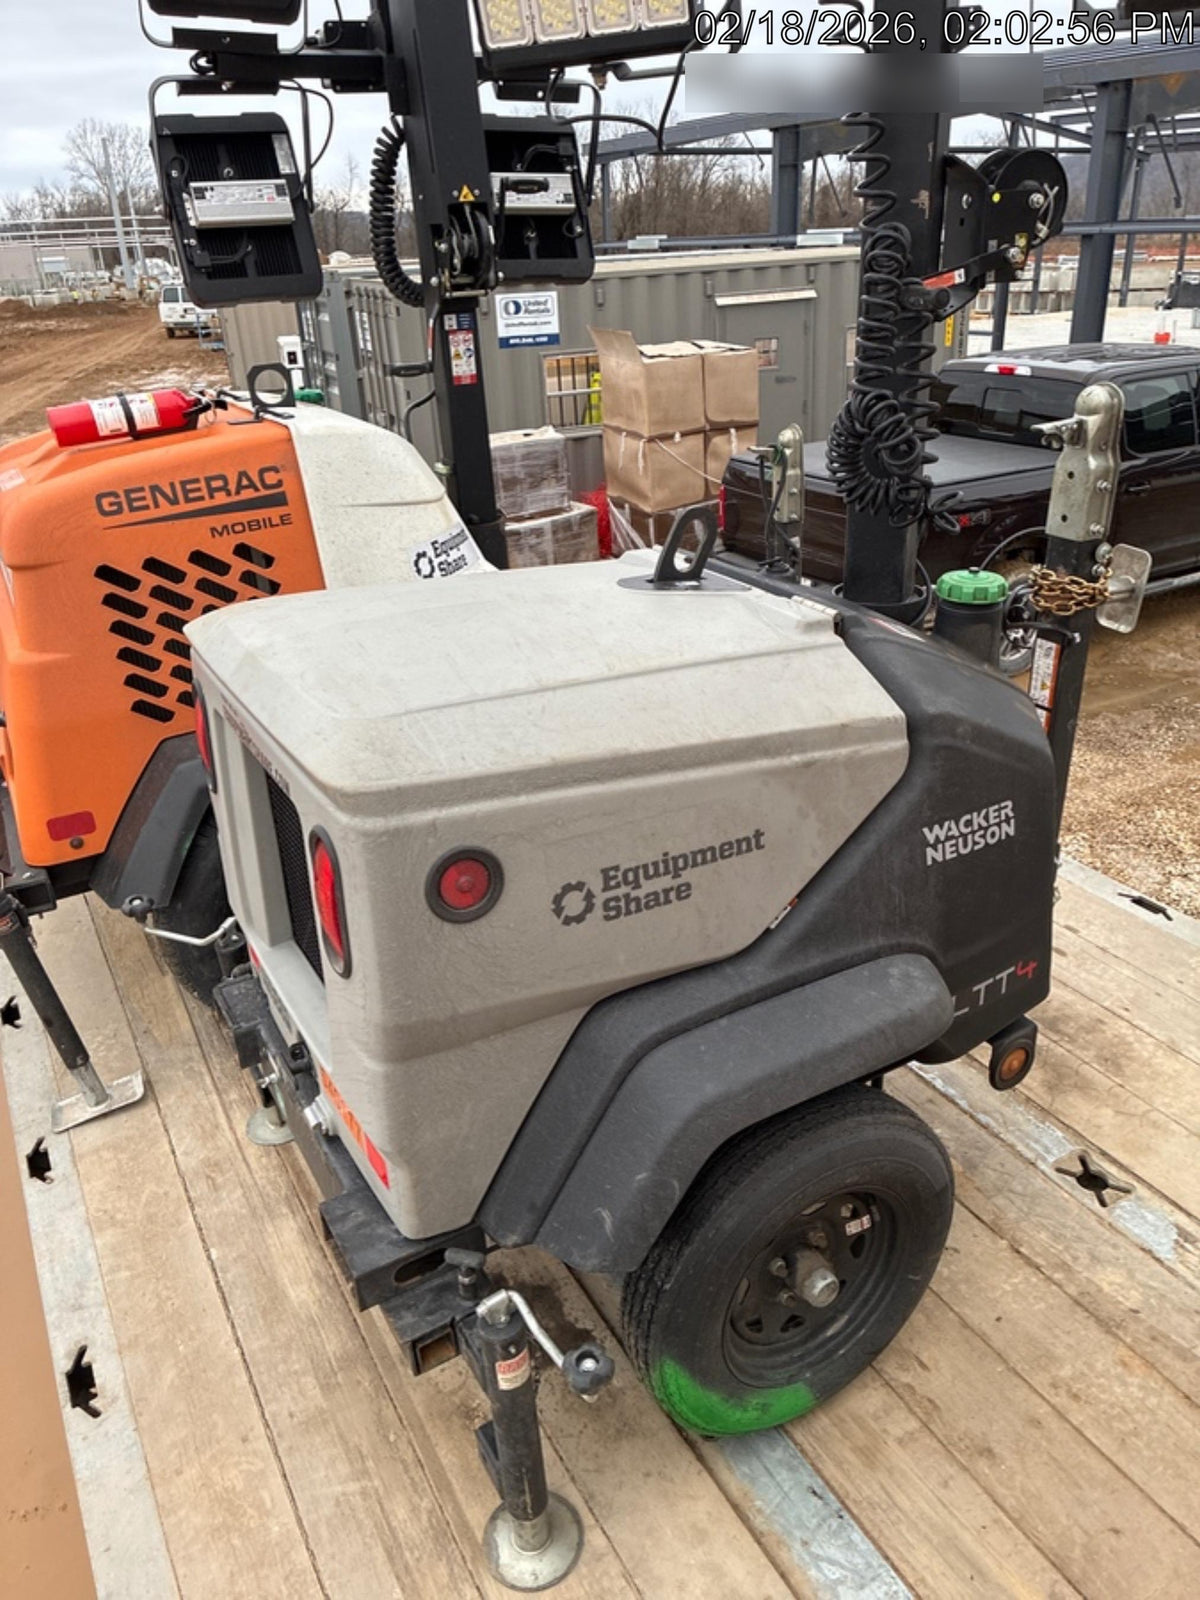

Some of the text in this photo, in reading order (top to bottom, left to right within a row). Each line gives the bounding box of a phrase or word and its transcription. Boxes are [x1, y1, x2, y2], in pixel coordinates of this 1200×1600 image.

[95, 465, 284, 518] GENERAC
[209, 513, 293, 539] MOBILE
[922, 799, 1015, 845] WACKER
[925, 818, 1016, 866] NEUSON
[600, 828, 765, 893] Equipment
[602, 880, 692, 921] Share
